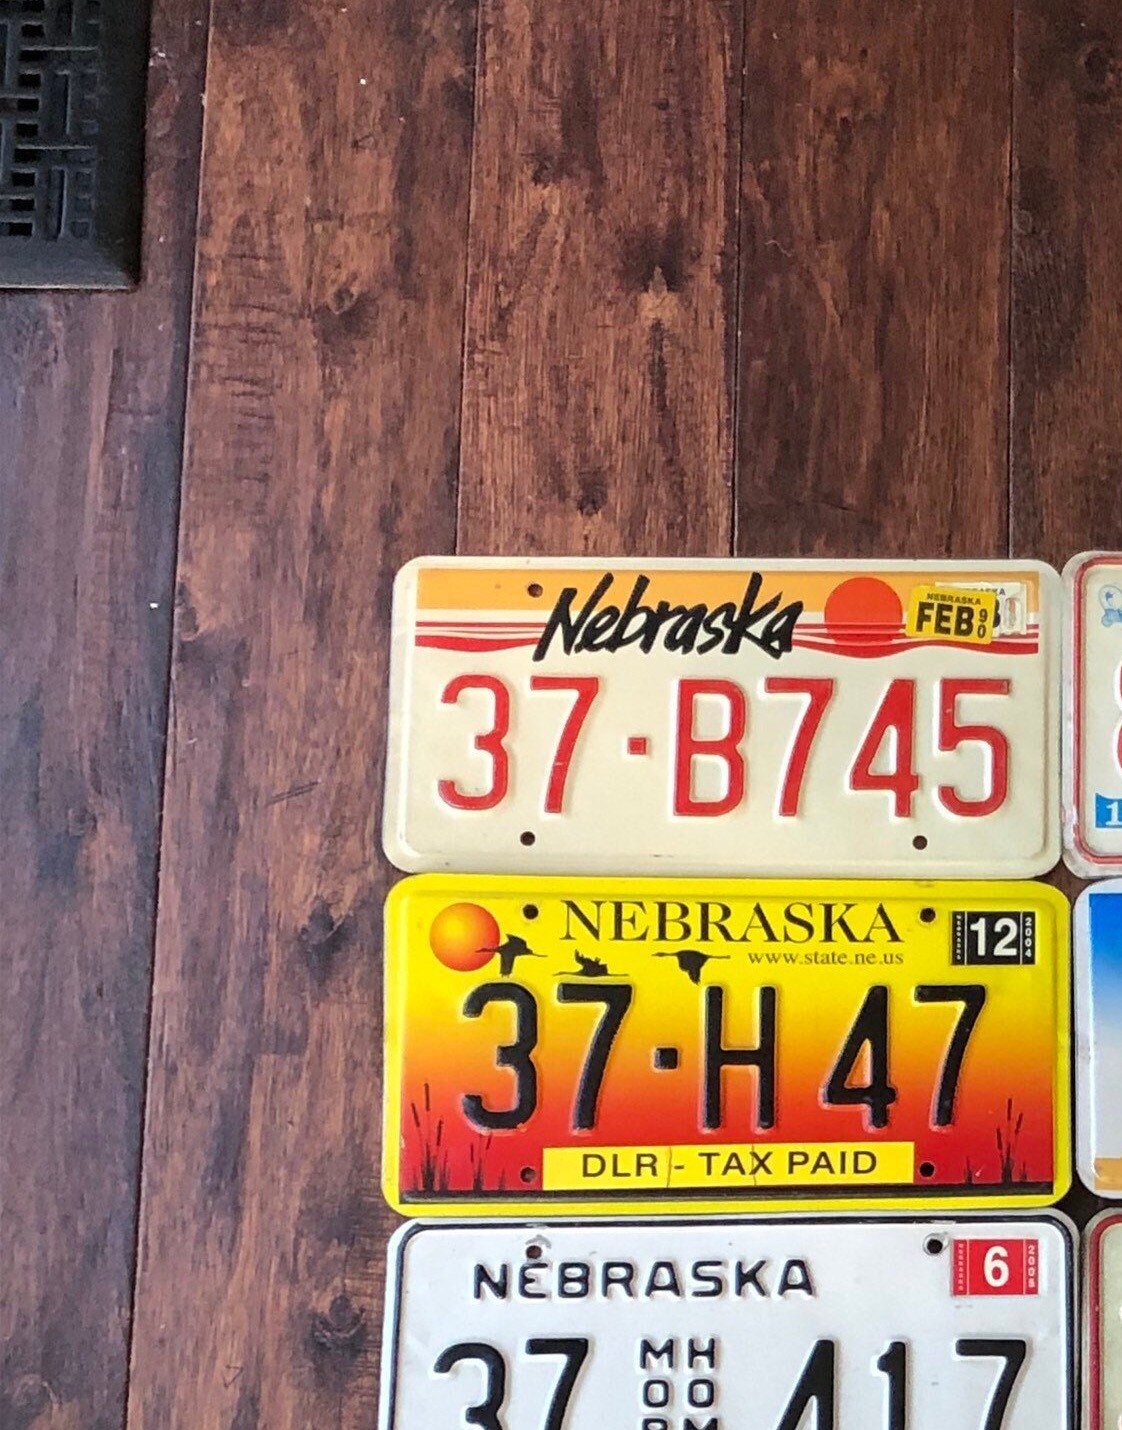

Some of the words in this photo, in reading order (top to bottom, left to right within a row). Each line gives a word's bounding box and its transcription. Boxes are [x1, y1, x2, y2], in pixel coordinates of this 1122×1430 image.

[532, 572, 803, 661] Nebraska
[916, 601, 974, 636] FEB
[560, 900, 904, 943] NEBRASKA
[970, 917, 1017, 956] 12
[748, 951, 904, 965] www.state.ne.us
[582, 1151, 658, 1179] DLR
[698, 1151, 770, 1176] TAX
[788, 1150, 877, 1176] PAID
[473, 1259, 814, 1300] NEBRASKA
[984, 1246, 1009, 1287] 6
